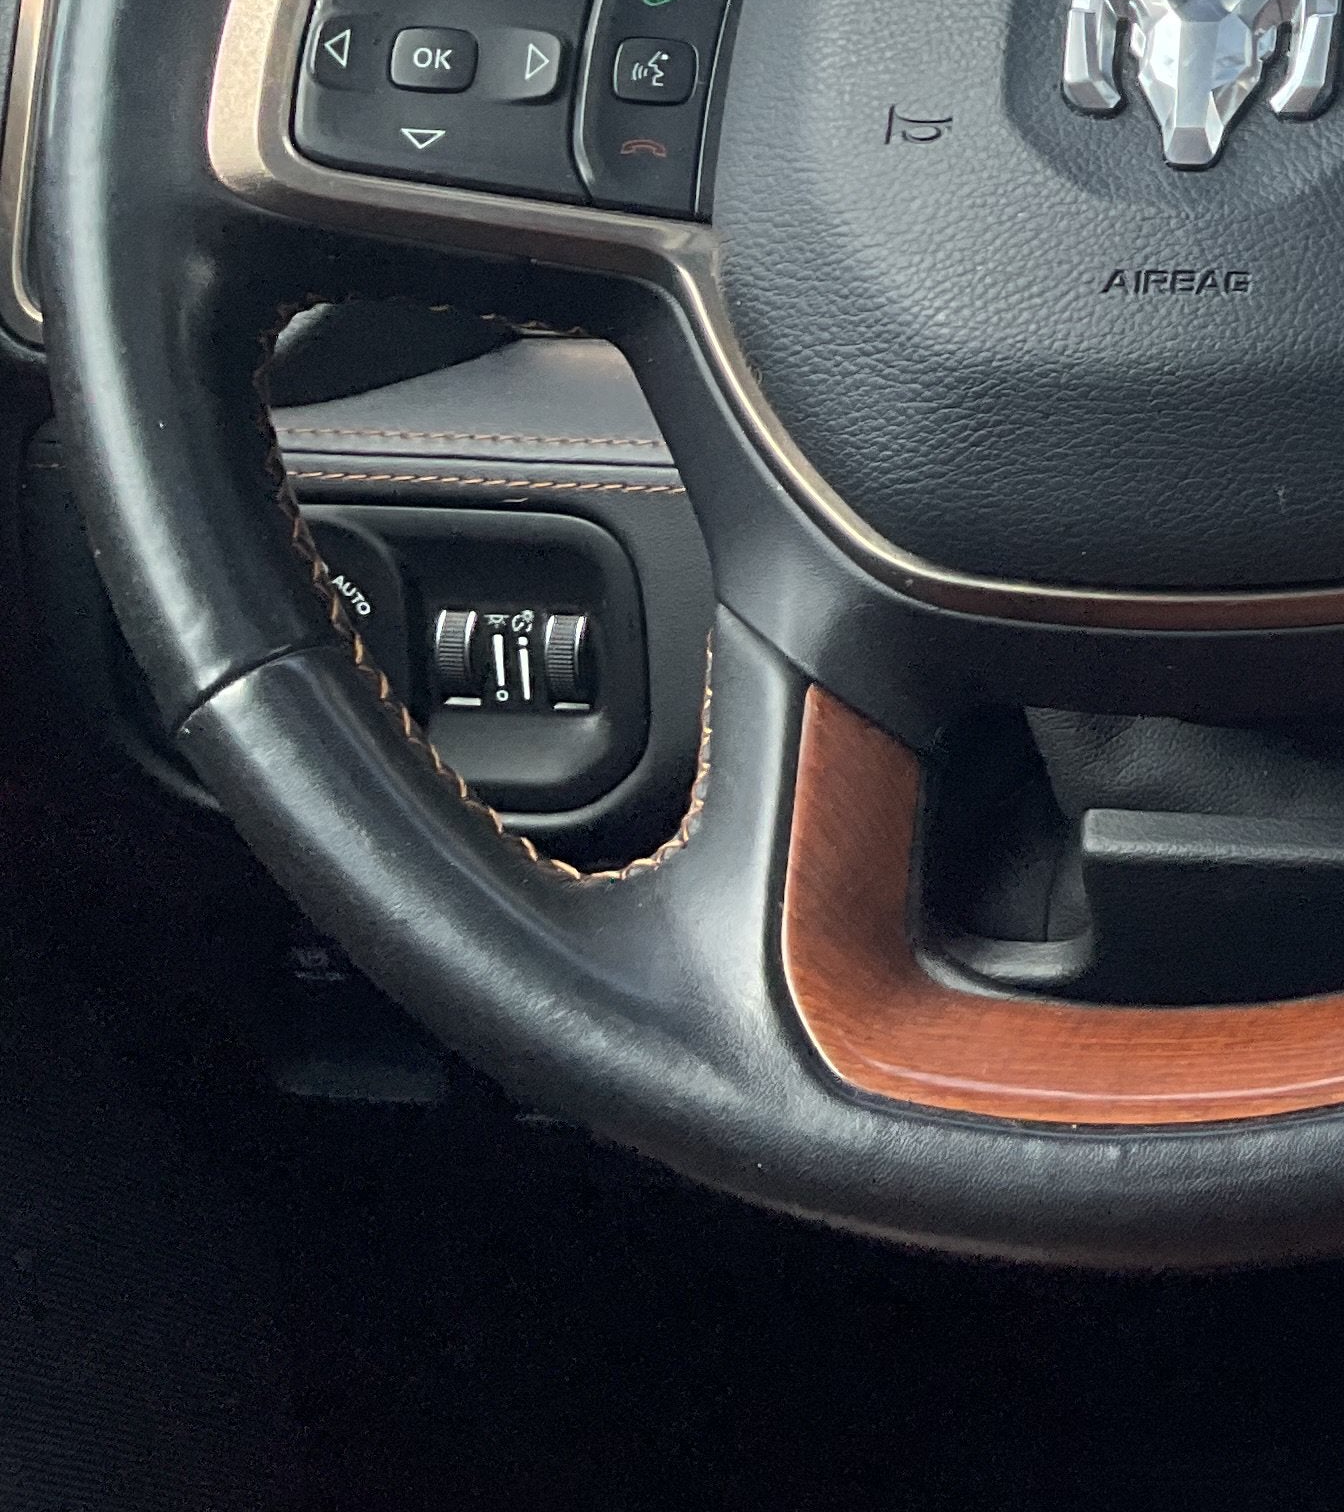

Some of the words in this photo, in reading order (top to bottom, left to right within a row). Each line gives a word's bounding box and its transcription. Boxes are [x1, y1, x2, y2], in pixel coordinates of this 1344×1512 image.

[413, 48, 452, 69] OK
[1101, 269, 1252, 294] AIRBAG
[331, 576, 370, 615] AUTO
